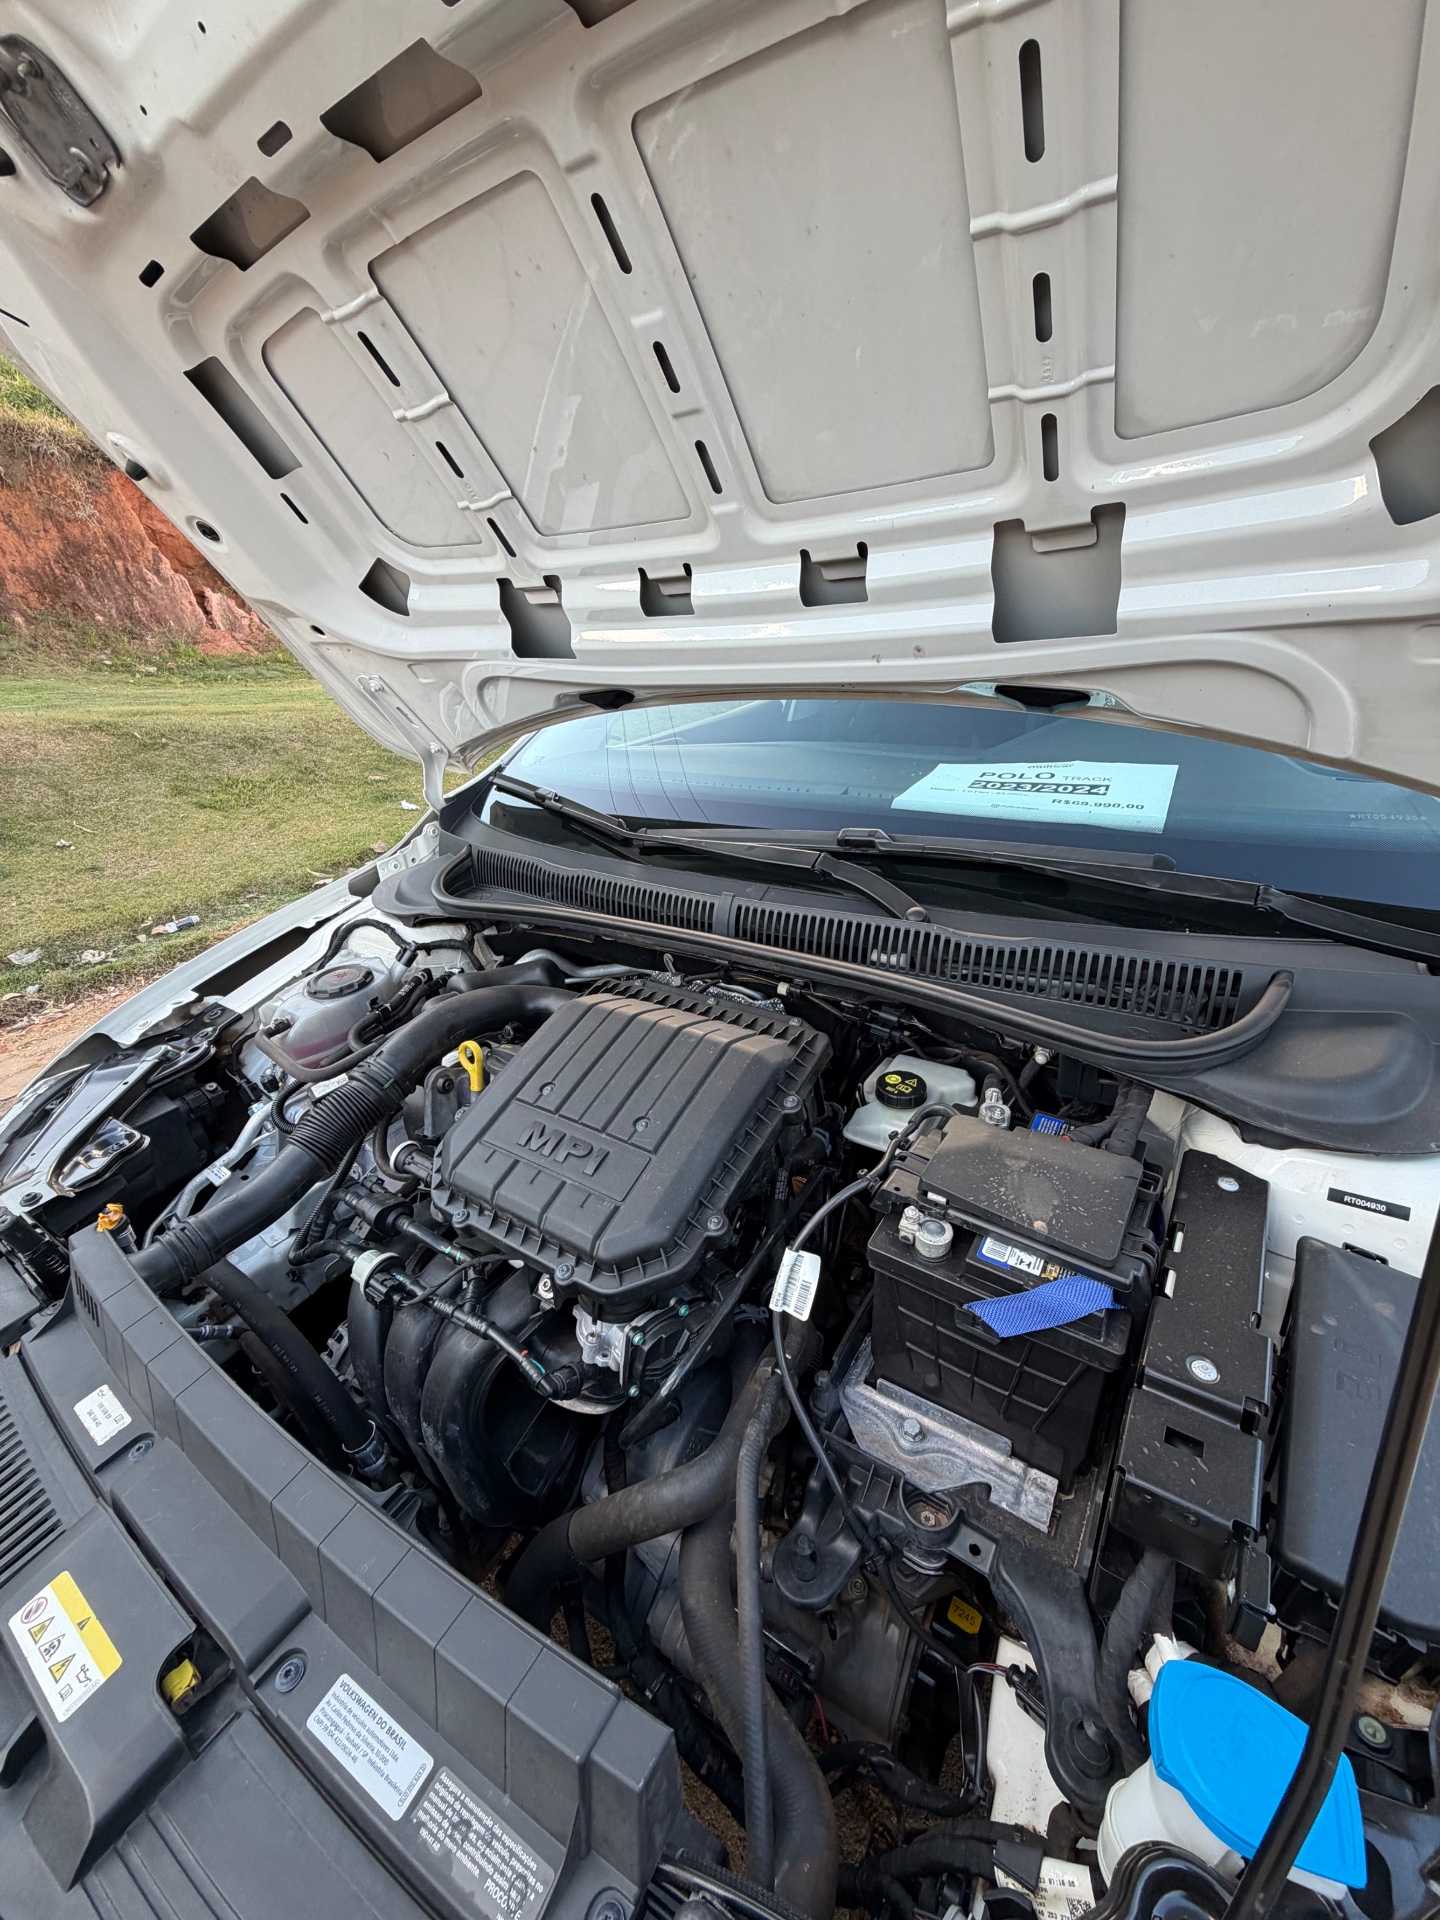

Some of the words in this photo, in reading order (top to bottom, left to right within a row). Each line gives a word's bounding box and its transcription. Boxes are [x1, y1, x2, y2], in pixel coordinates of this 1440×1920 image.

[970, 781, 1108, 795] 2023/2024
[979, 772, 1056, 780] POLO
[1052, 799, 1145, 810] R$69.990,00
[517, 1120, 610, 1177] MPI
[1343, 1195, 1387, 1212] RT004930
[953, 1604, 976, 1626] 7245
[331, 1704, 343, 1719] Carlos
[341, 1715, 357, 1733] Pedroso
[340, 1680, 378, 1721] VOLKSWAGEN
[376, 1716, 387, 1730] DO
[385, 1726, 406, 1750] BRASIL
[347, 1707, 353, 1715] de
[366, 1727, 390, 1753] automotores
[389, 1749, 399, 1763] Ltda.
[384, 1774, 403, 1796] Brasileira
[429, 1792, 446, 1811] manual
[446, 1808, 453, 1817] de
[440, 1772, 461, 1796] Assegure
[493, 1824, 502, 1837] das
[502, 1834, 537, 1871] especificações
[435, 1783, 454, 1804] originais
[454, 1801, 461, 1810] de
[509, 1857, 536, 1885] prescritas
[535, 1882, 543, 1893] no
[438, 1830, 445, 1840] do
[444, 1837, 457, 1853] meio
[456, 1850, 479, 1878] ambiente.
[442, 1820, 449, 1829] de
[463, 1841, 494, 1875] contribuindo
[493, 1872, 509, 1889] assim
